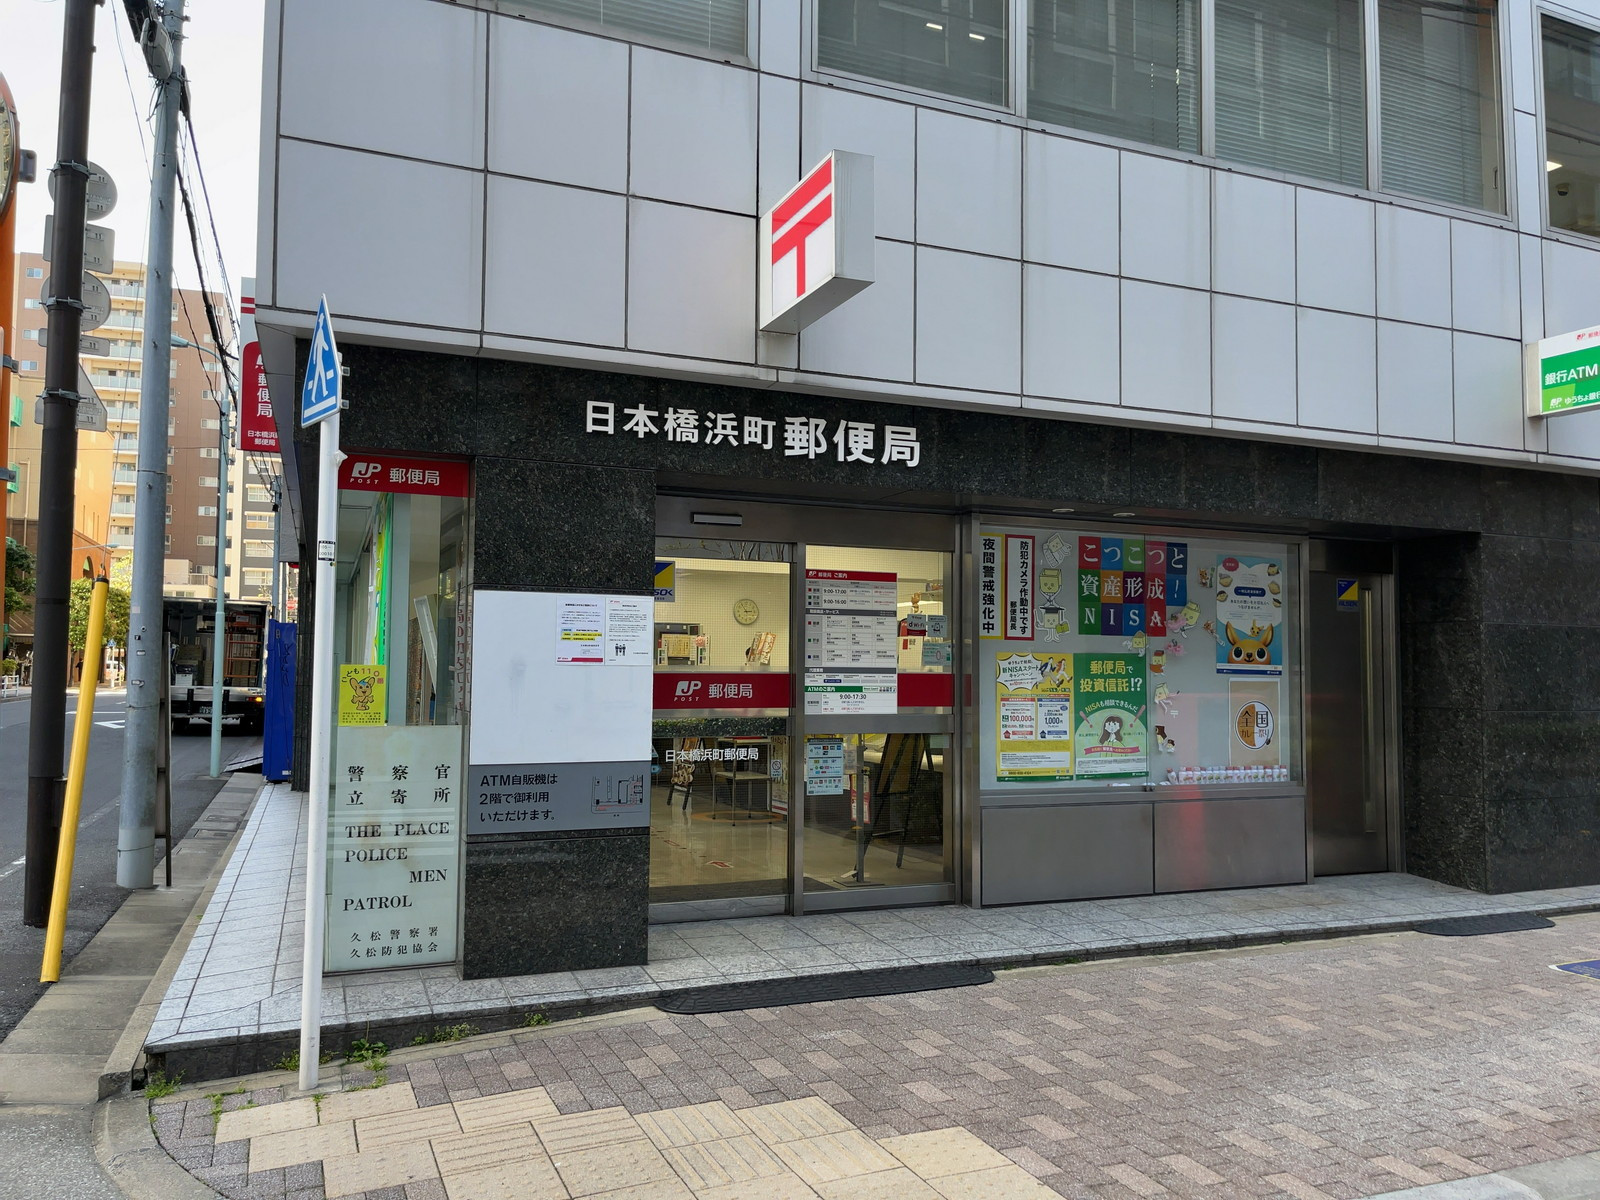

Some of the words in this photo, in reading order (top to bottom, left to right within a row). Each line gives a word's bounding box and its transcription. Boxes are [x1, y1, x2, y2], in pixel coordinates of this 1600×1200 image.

[1545, 363, 1598, 385] 銀行ATM
[247, 430, 278, 439] 日本橋浜
[585, 400, 921, 467] 日本橋浜町郵便局
[389, 467, 440, 486] 郵便局
[1083, 543, 1185, 569] こつこつと
[982, 538, 995, 634] 夜間警戒強化中
[1020, 541, 1029, 635] 防犯カメラ作動中です
[1081, 574, 1179, 600] 資産形成!
[1010, 601, 1018, 631] 郵便局長
[1083, 607, 1163, 628] NISA
[1002, 664, 1039, 674] 新NISAスタート
[1090, 660, 1134, 675] 郵便局で
[708, 683, 753, 699] 郵便局
[1080, 677, 1143, 692] 投資信託!?
[1240, 710, 1269, 728] 全国
[665, 748, 759, 763] 日本橋浜町郵便局
[347, 763, 451, 782] 警察官
[480, 773, 558, 787] ATM自販機は
[346, 787, 451, 806] 立寄所
[480, 791, 549, 805] 2階で御利用
[480, 810, 555, 822] いただけます。
[345, 824, 382, 839] THE
[393, 821, 450, 837] PLACE
[344, 848, 408, 863] POLICE
[409, 869, 448, 884] MEN
[342, 895, 413, 912] PATROL
[350, 926, 439, 942] 久松警察署
[350, 941, 439, 959] 久松防犯協会
